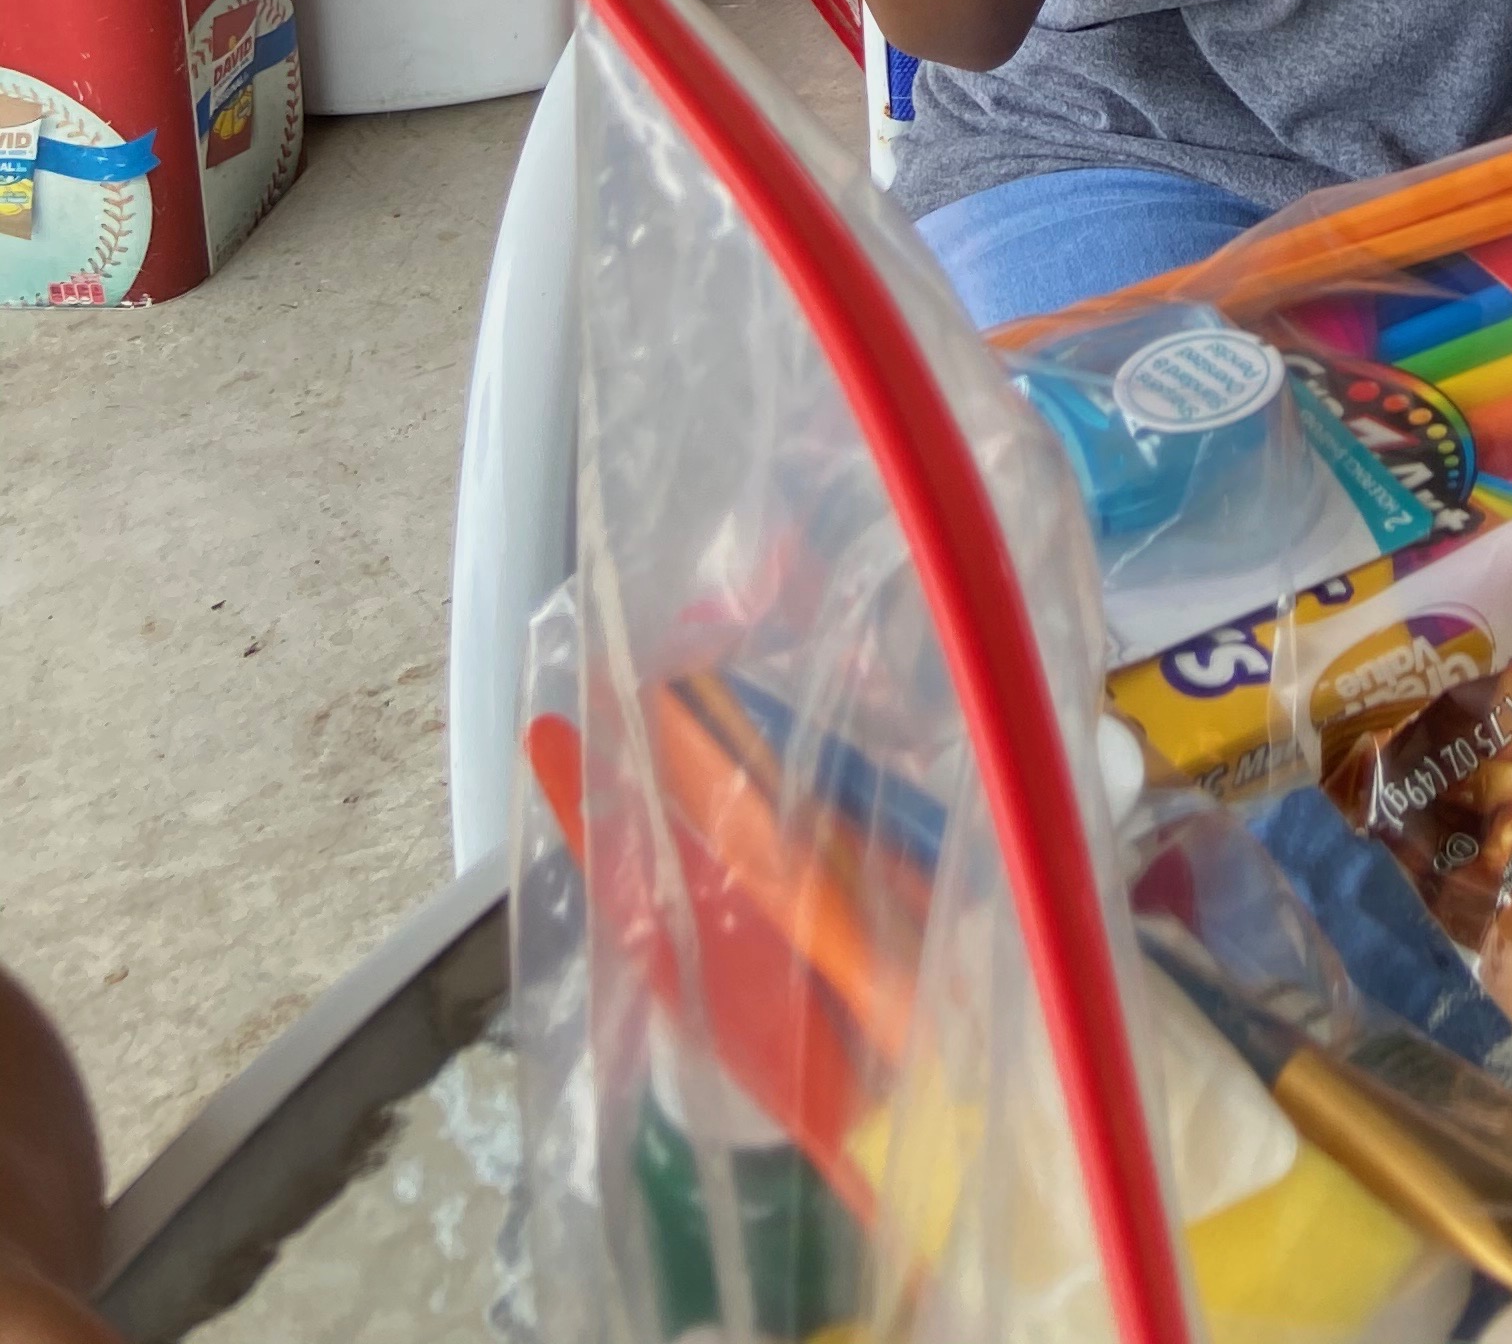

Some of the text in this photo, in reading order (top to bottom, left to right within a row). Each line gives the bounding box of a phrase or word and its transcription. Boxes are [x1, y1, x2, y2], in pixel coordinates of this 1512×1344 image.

[213, 35, 253, 86] DAVID
[0, 131, 33, 150] VID
[1206, 339, 1260, 380] Pencils
[1167, 364, 1227, 412] Standard
[1284, 352, 1472, 535] CraZArt
[1334, 635, 1437, 700] Value
[1440, 738, 1480, 777] OZ
[1378, 749, 1450, 831] (49g)
